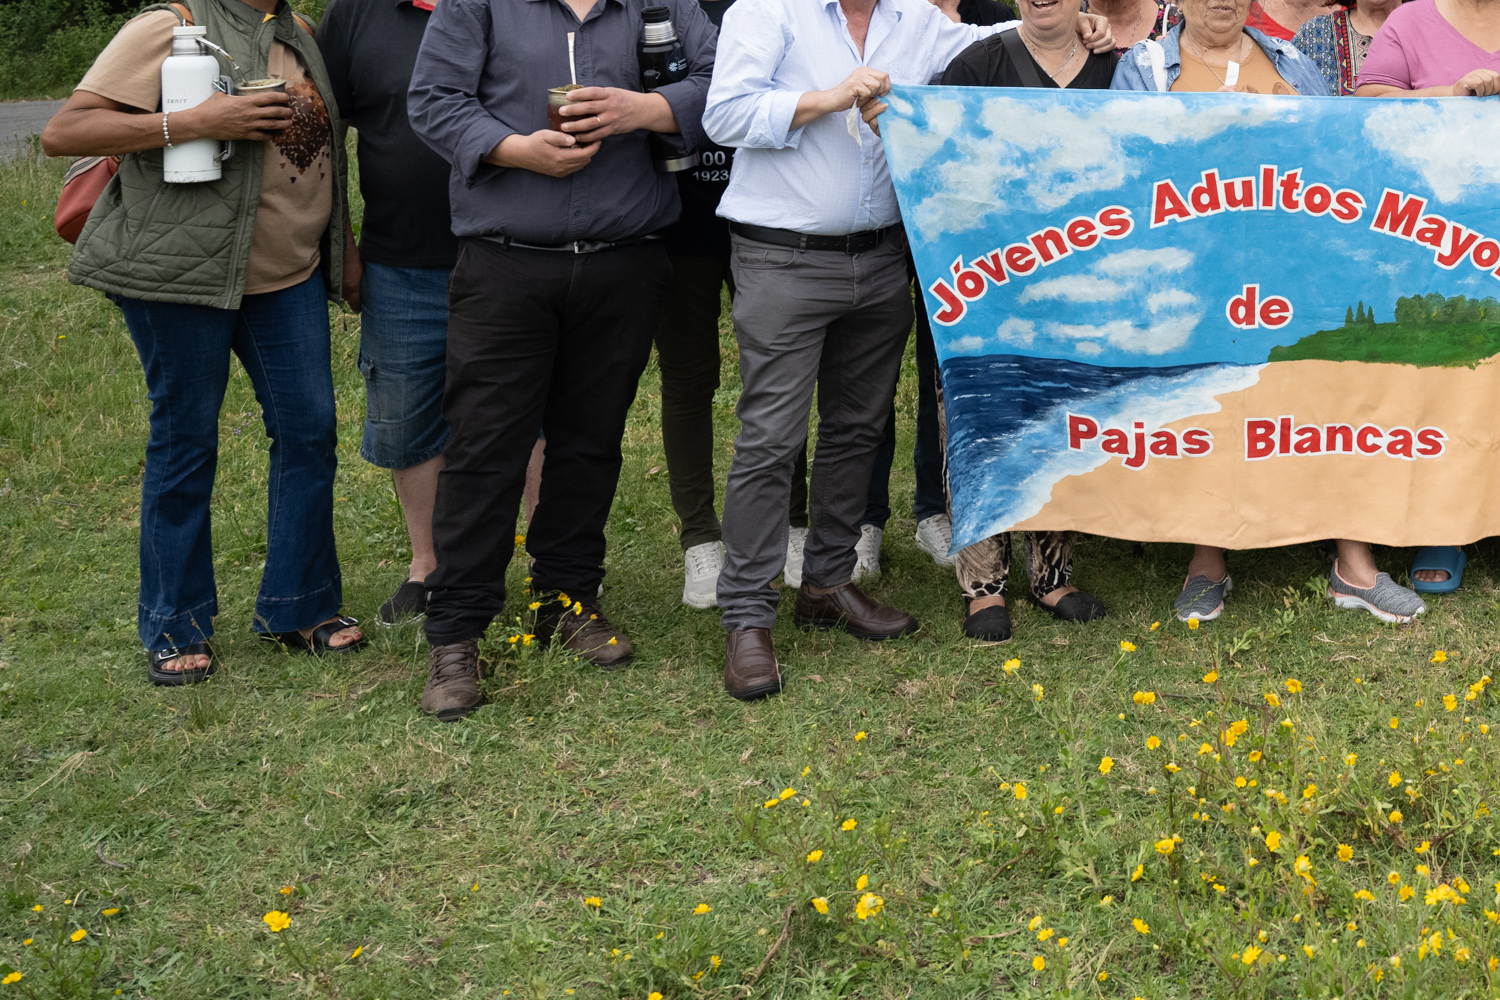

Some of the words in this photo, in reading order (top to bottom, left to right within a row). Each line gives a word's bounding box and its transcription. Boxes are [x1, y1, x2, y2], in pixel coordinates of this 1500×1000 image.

[692, 169, 729, 182] 1923
[931, 206, 1133, 325] Jóvenes
[1152, 165, 1364, 226] Adultos
[1227, 284, 1292, 328] de
[1068, 413, 1212, 470] Pajas
[1245, 415, 1446, 460] Blancas
